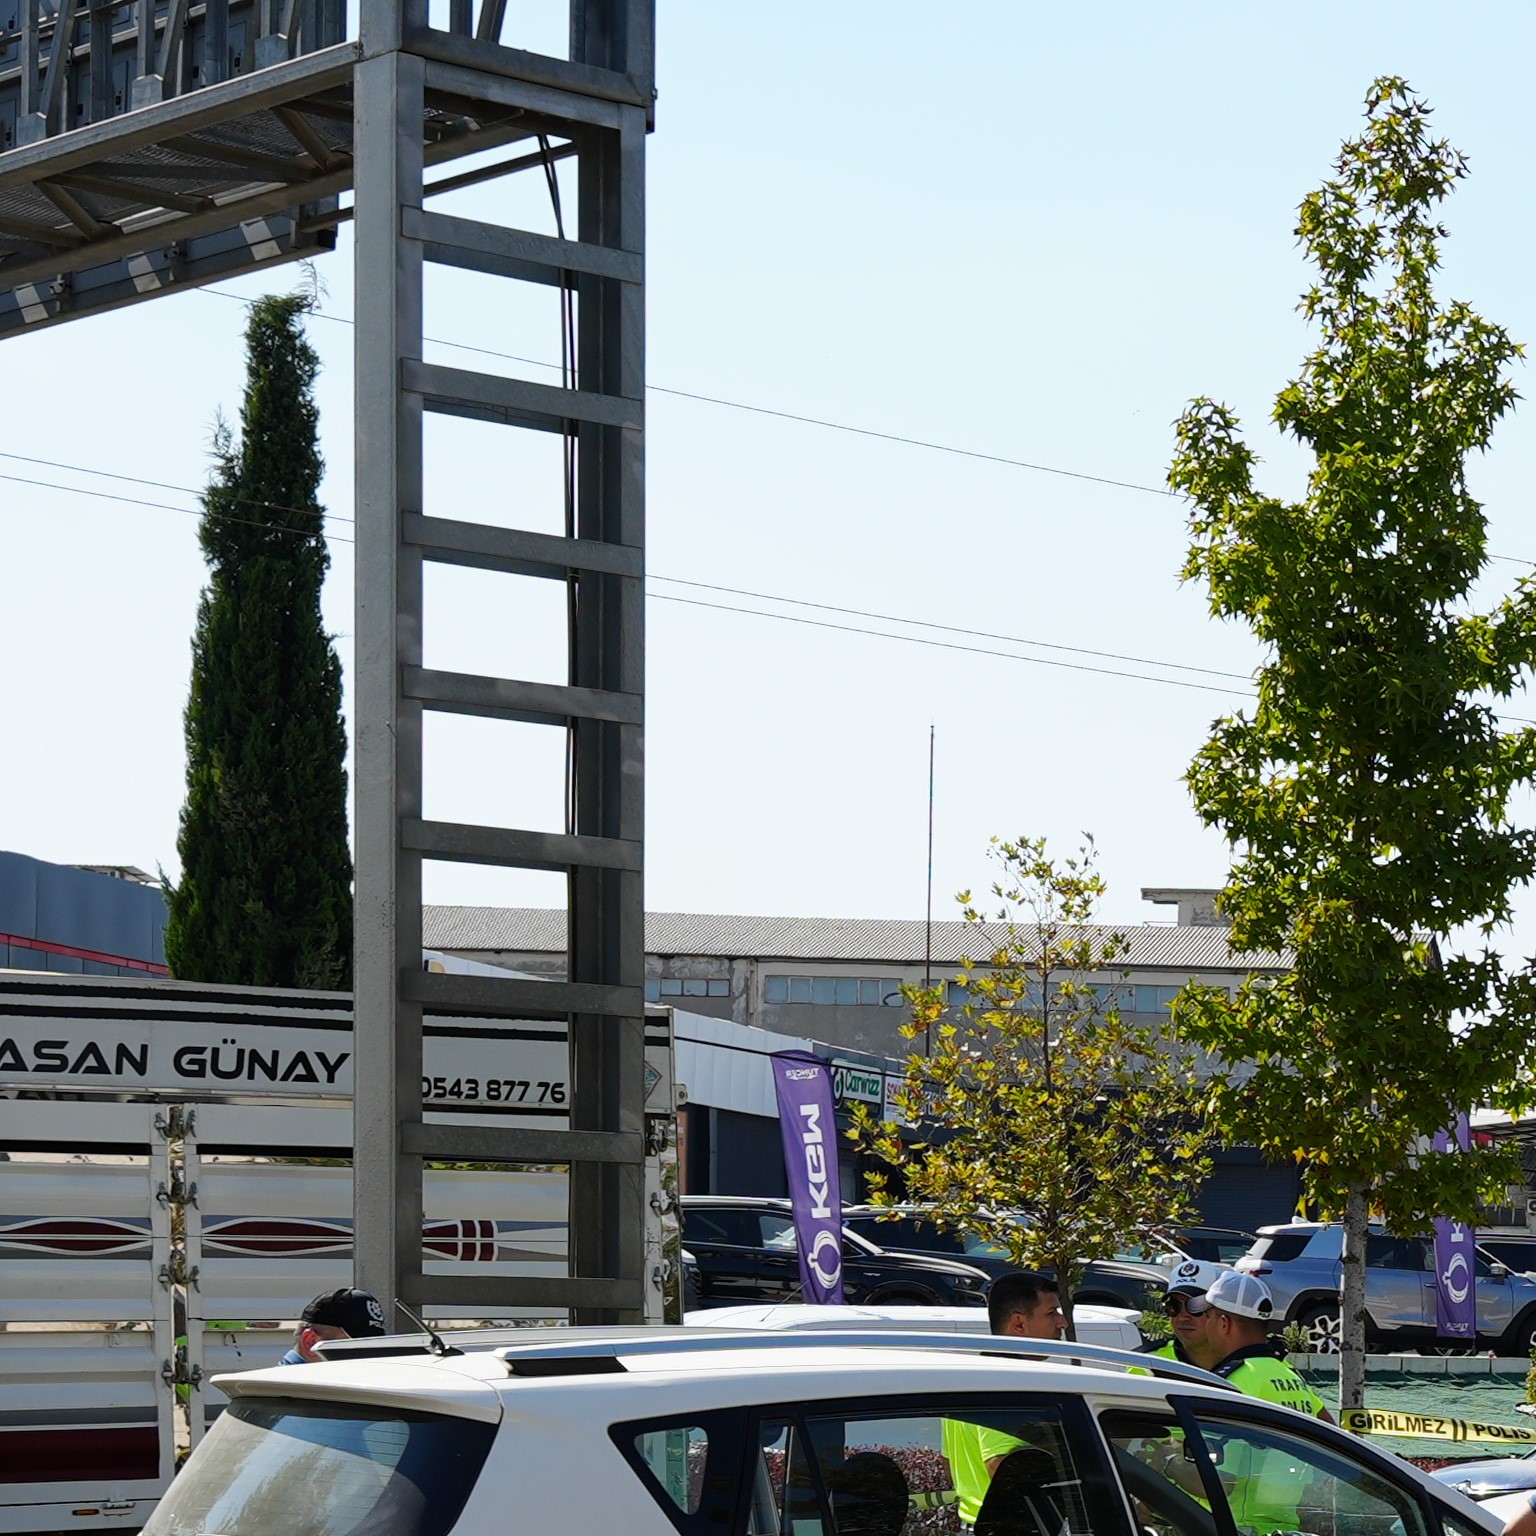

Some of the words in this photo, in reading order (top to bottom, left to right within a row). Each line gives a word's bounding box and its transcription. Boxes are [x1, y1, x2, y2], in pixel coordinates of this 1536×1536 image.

[173, 1038, 351, 1083] GÜNAY
[486, 1079, 530, 1101] 877
[537, 1082, 566, 1103] 76
